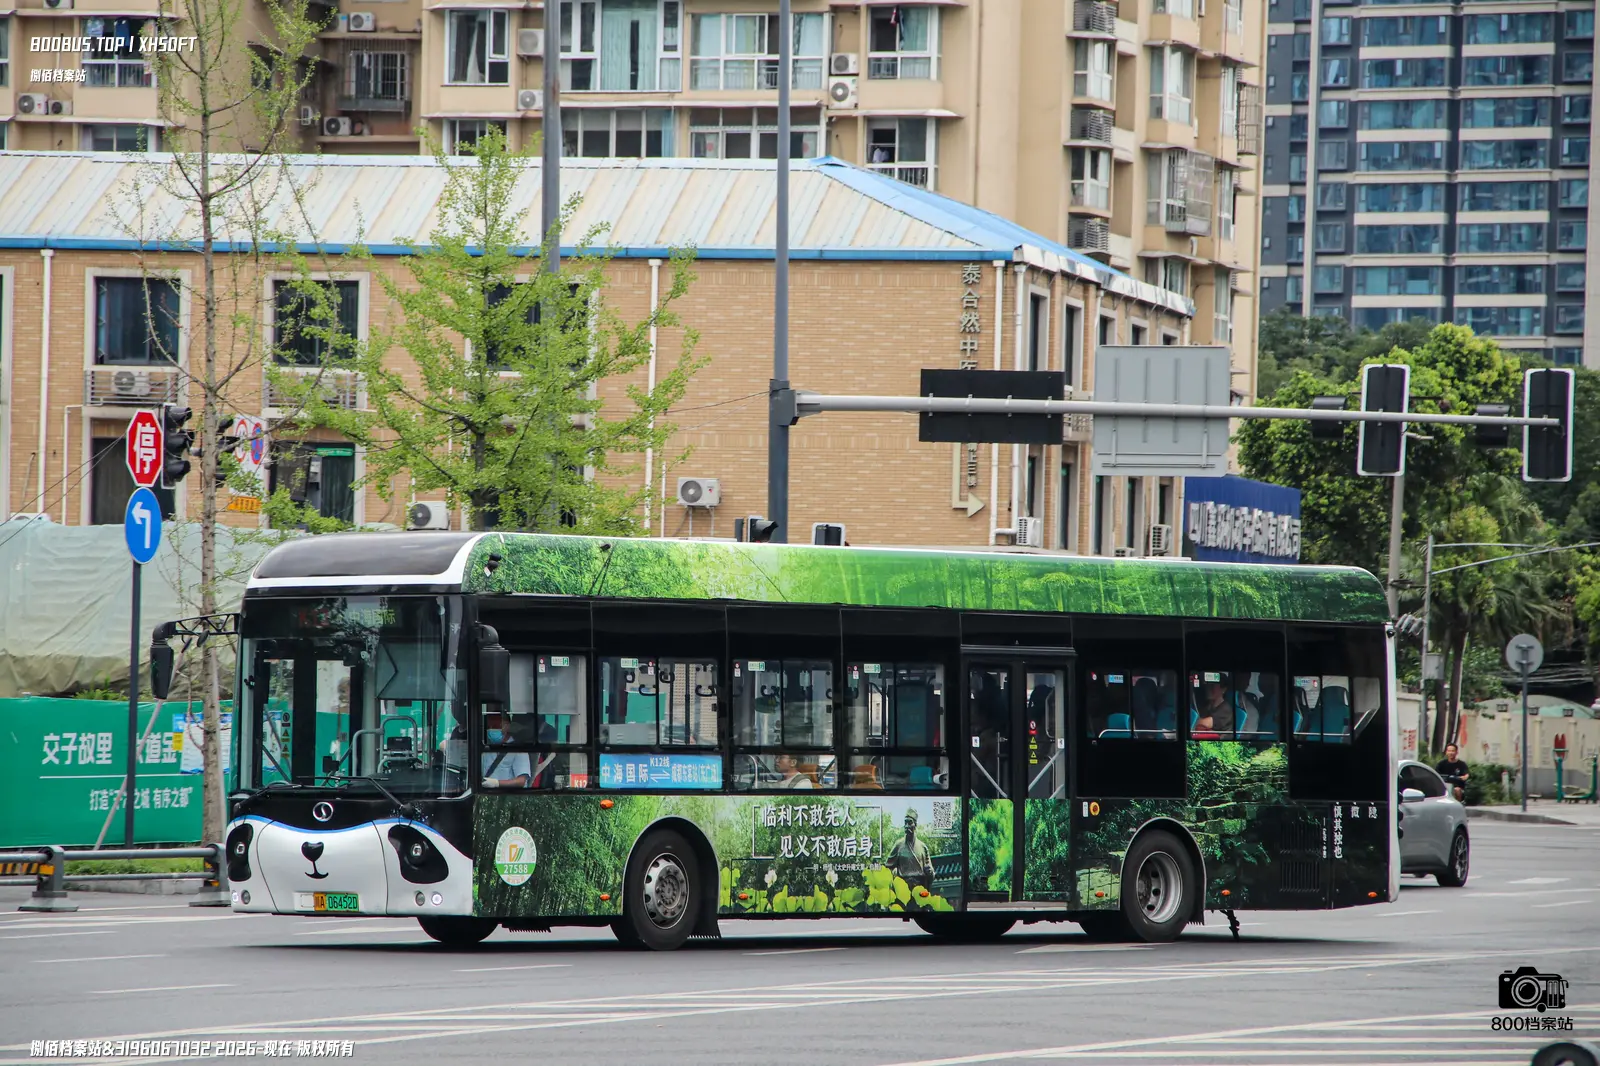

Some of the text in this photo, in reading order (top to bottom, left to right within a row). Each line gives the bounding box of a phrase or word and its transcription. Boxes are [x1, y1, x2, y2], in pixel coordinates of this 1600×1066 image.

[133, 421, 157, 475] 停
[41, 732, 113, 765] 交子故里
[602, 763, 648, 783] 中海国际
[762, 804, 858, 828] 临利不敢先人
[779, 834, 874, 859] 见义不敢后身
[503, 864, 528, 874] 27588
